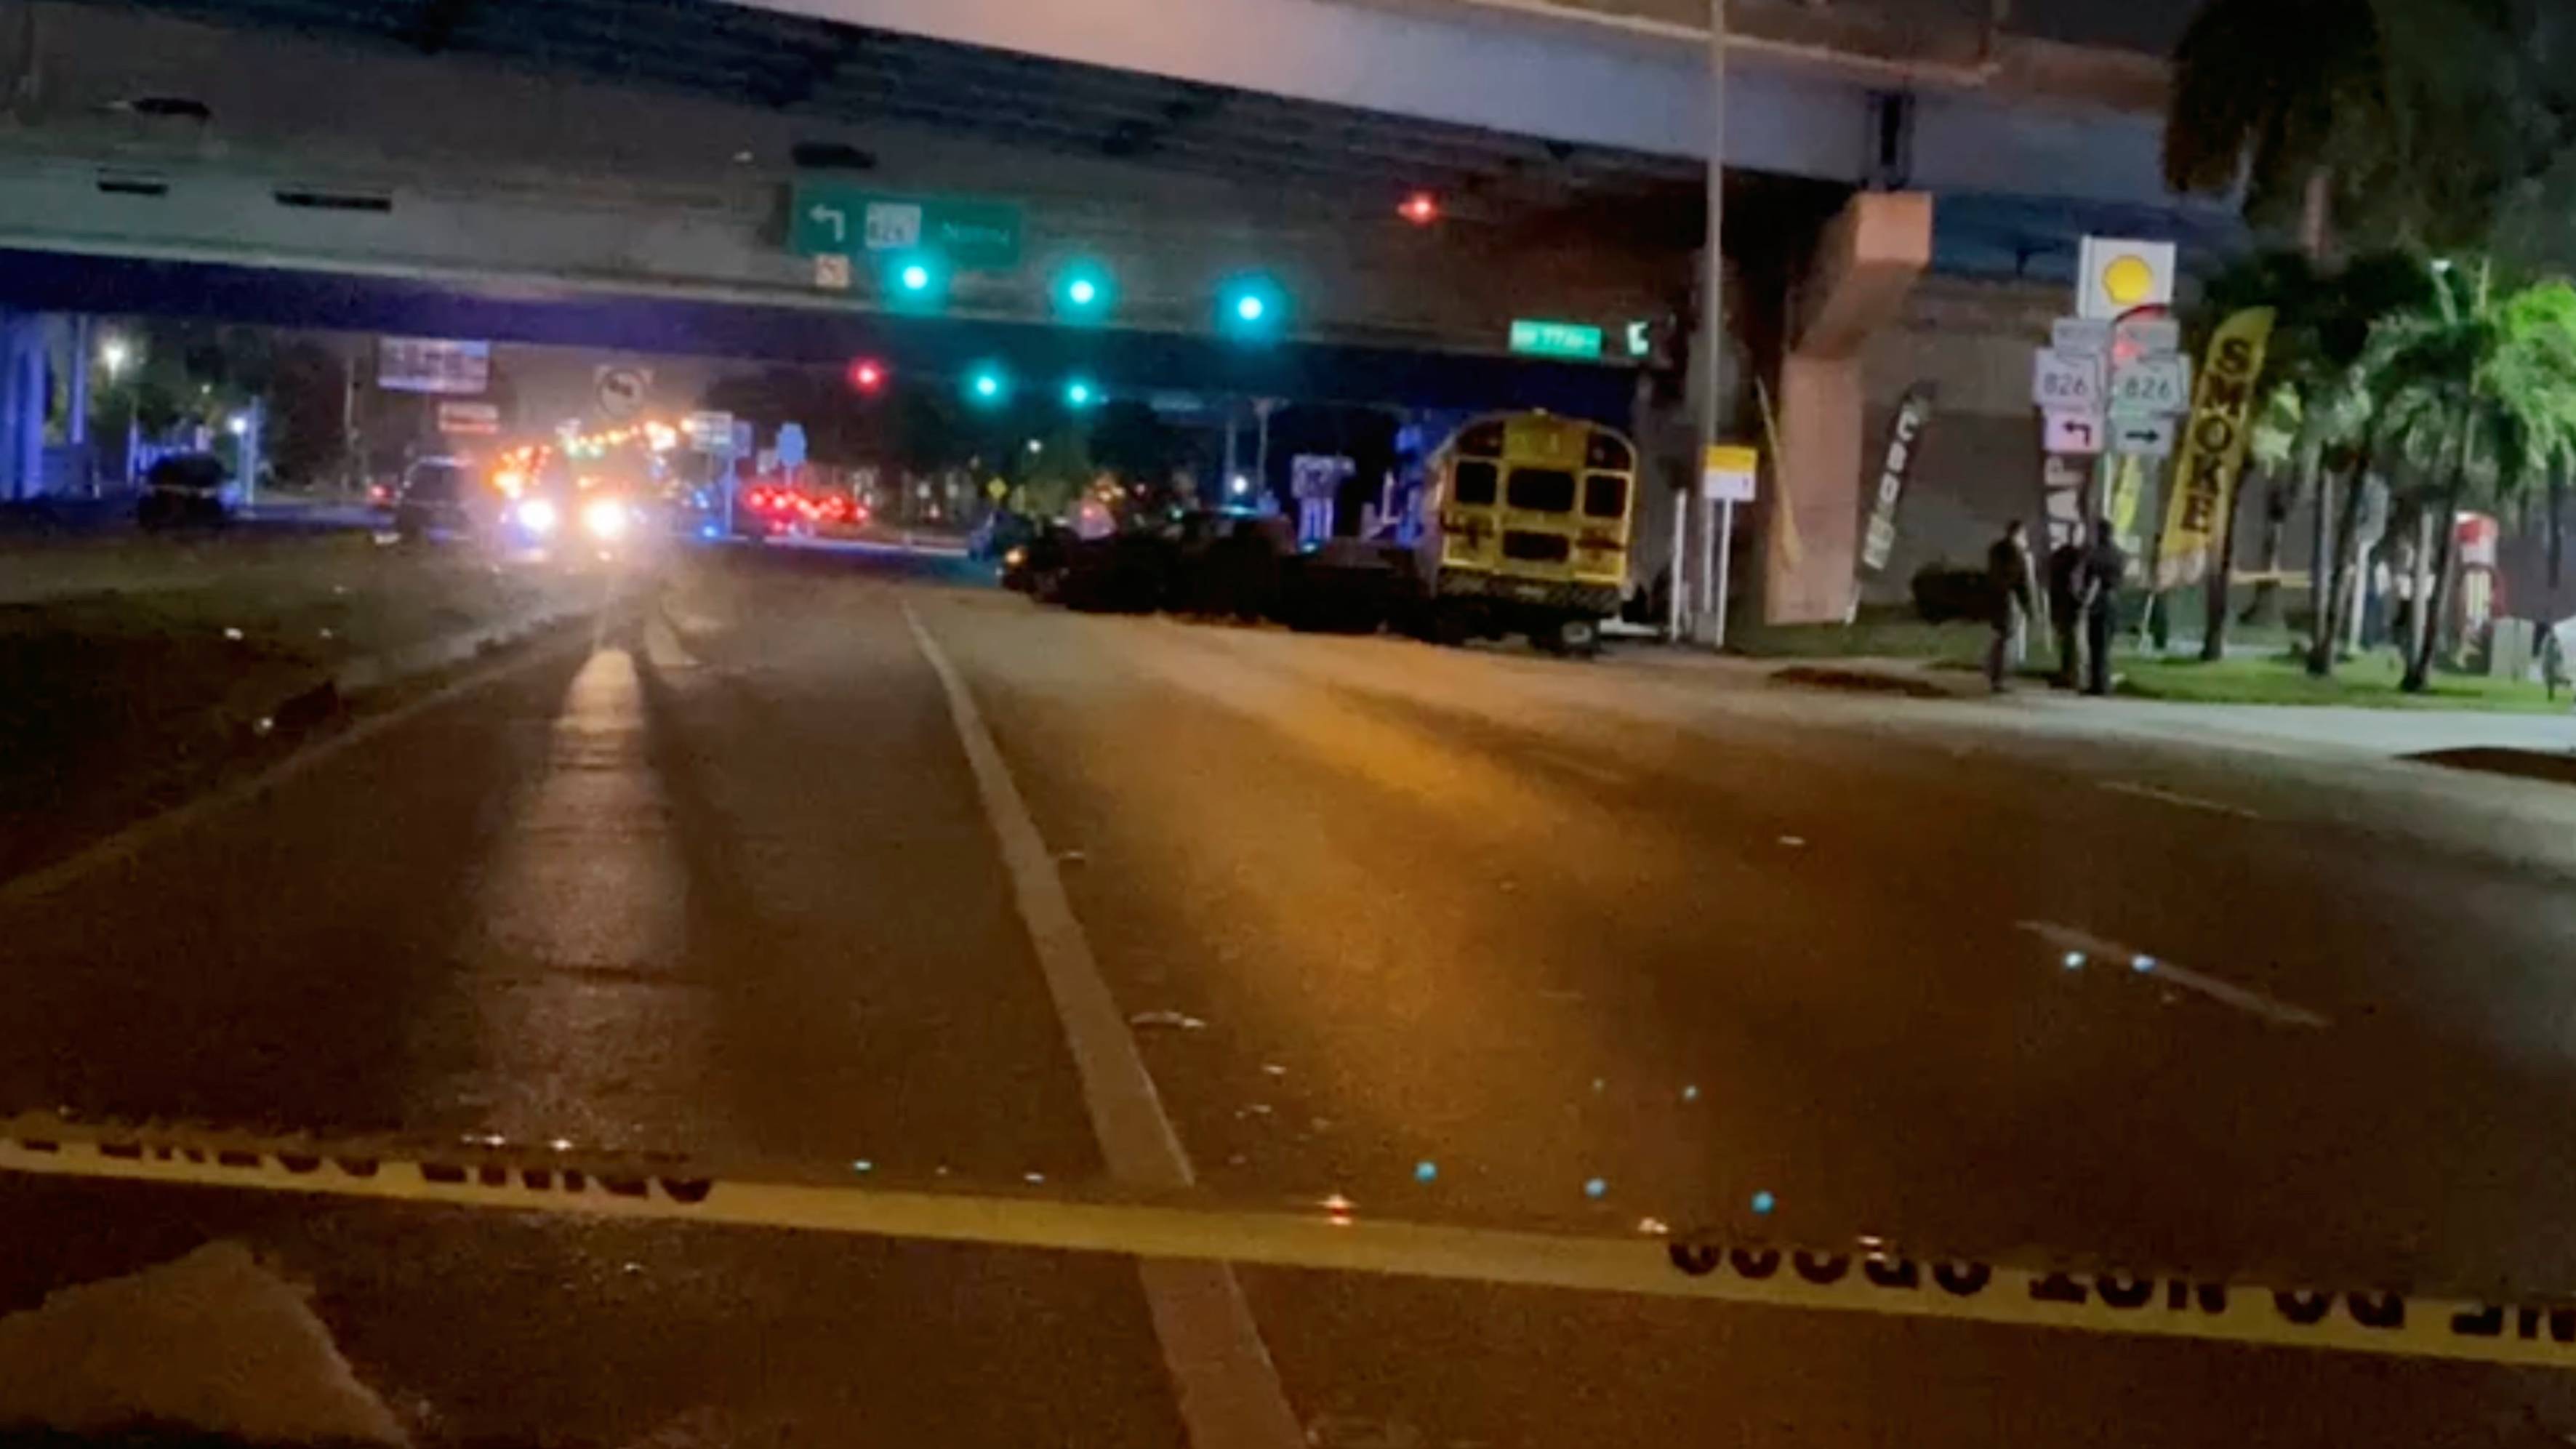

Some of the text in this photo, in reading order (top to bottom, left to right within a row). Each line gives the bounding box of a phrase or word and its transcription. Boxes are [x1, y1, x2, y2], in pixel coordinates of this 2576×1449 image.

[2044, 372, 2089, 396] 826
[2124, 375, 2172, 400] 826
[2180, 337, 2252, 534] SMOKE
